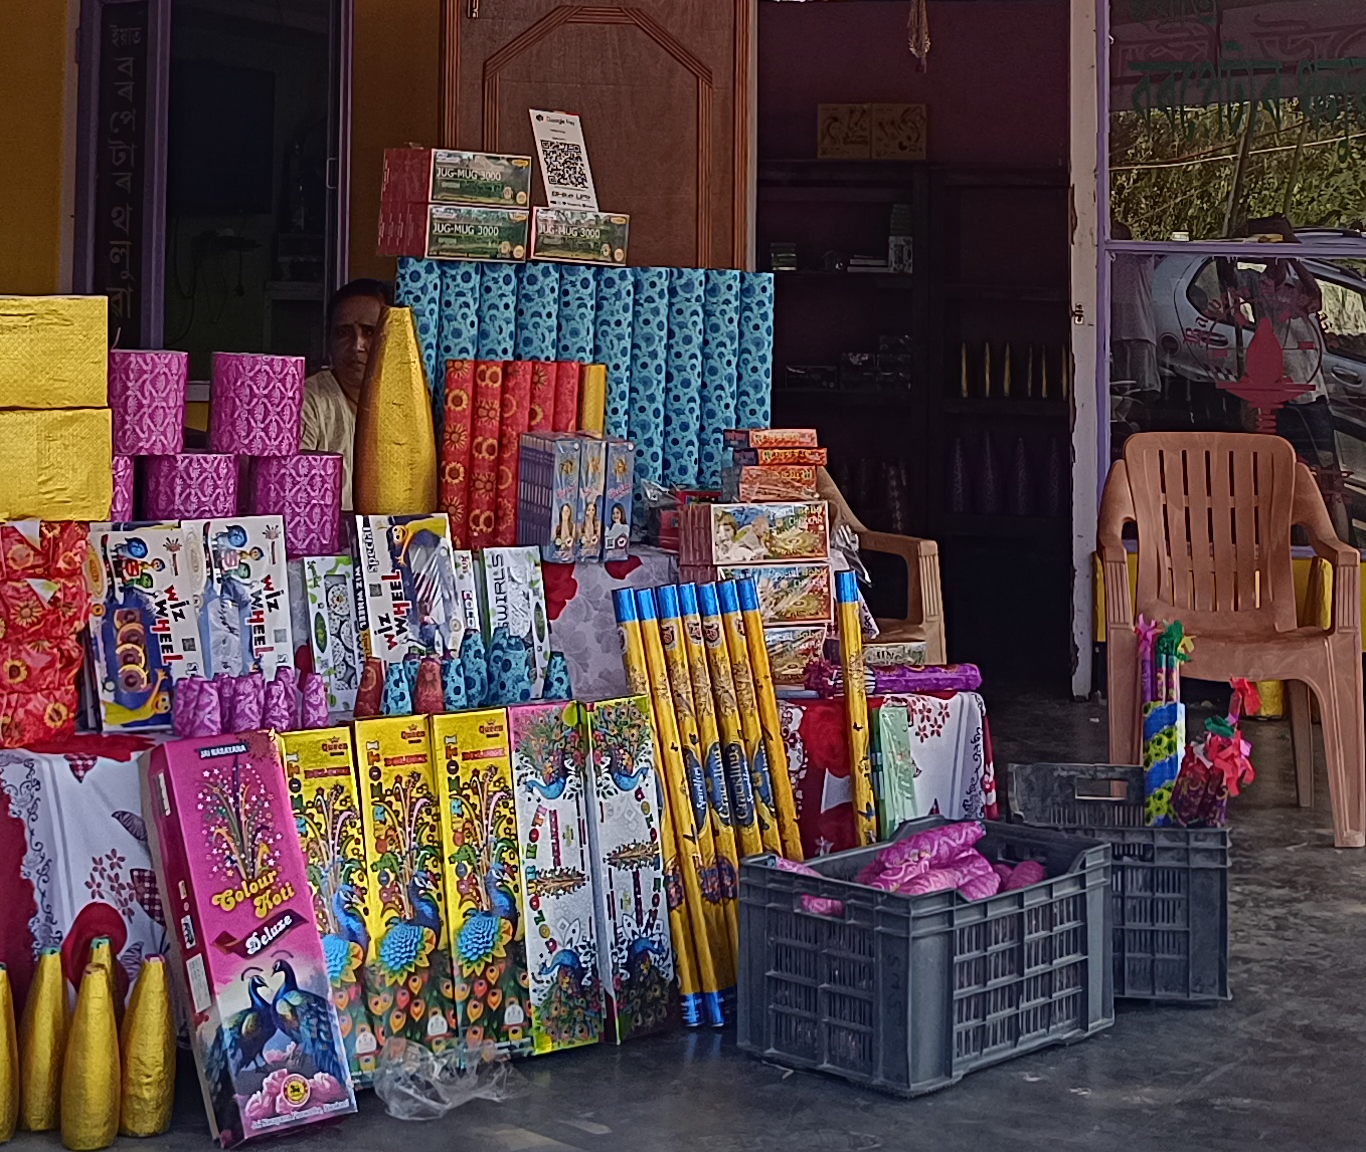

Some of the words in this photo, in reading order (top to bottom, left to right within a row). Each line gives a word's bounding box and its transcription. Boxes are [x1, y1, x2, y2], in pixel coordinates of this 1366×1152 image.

[437, 168, 477, 180] JUG-MUG
[481, 171, 501, 181] 3000
[433, 223, 474, 235] JUG-MUG
[478, 226, 499, 236] 3000
[539, 223, 578, 236] JUG-MUG
[580, 227, 601, 239] 3000
[212, 870, 277, 912] Colour
[253, 882, 296, 919] Koti
[245, 914, 294, 955] Deluxe
